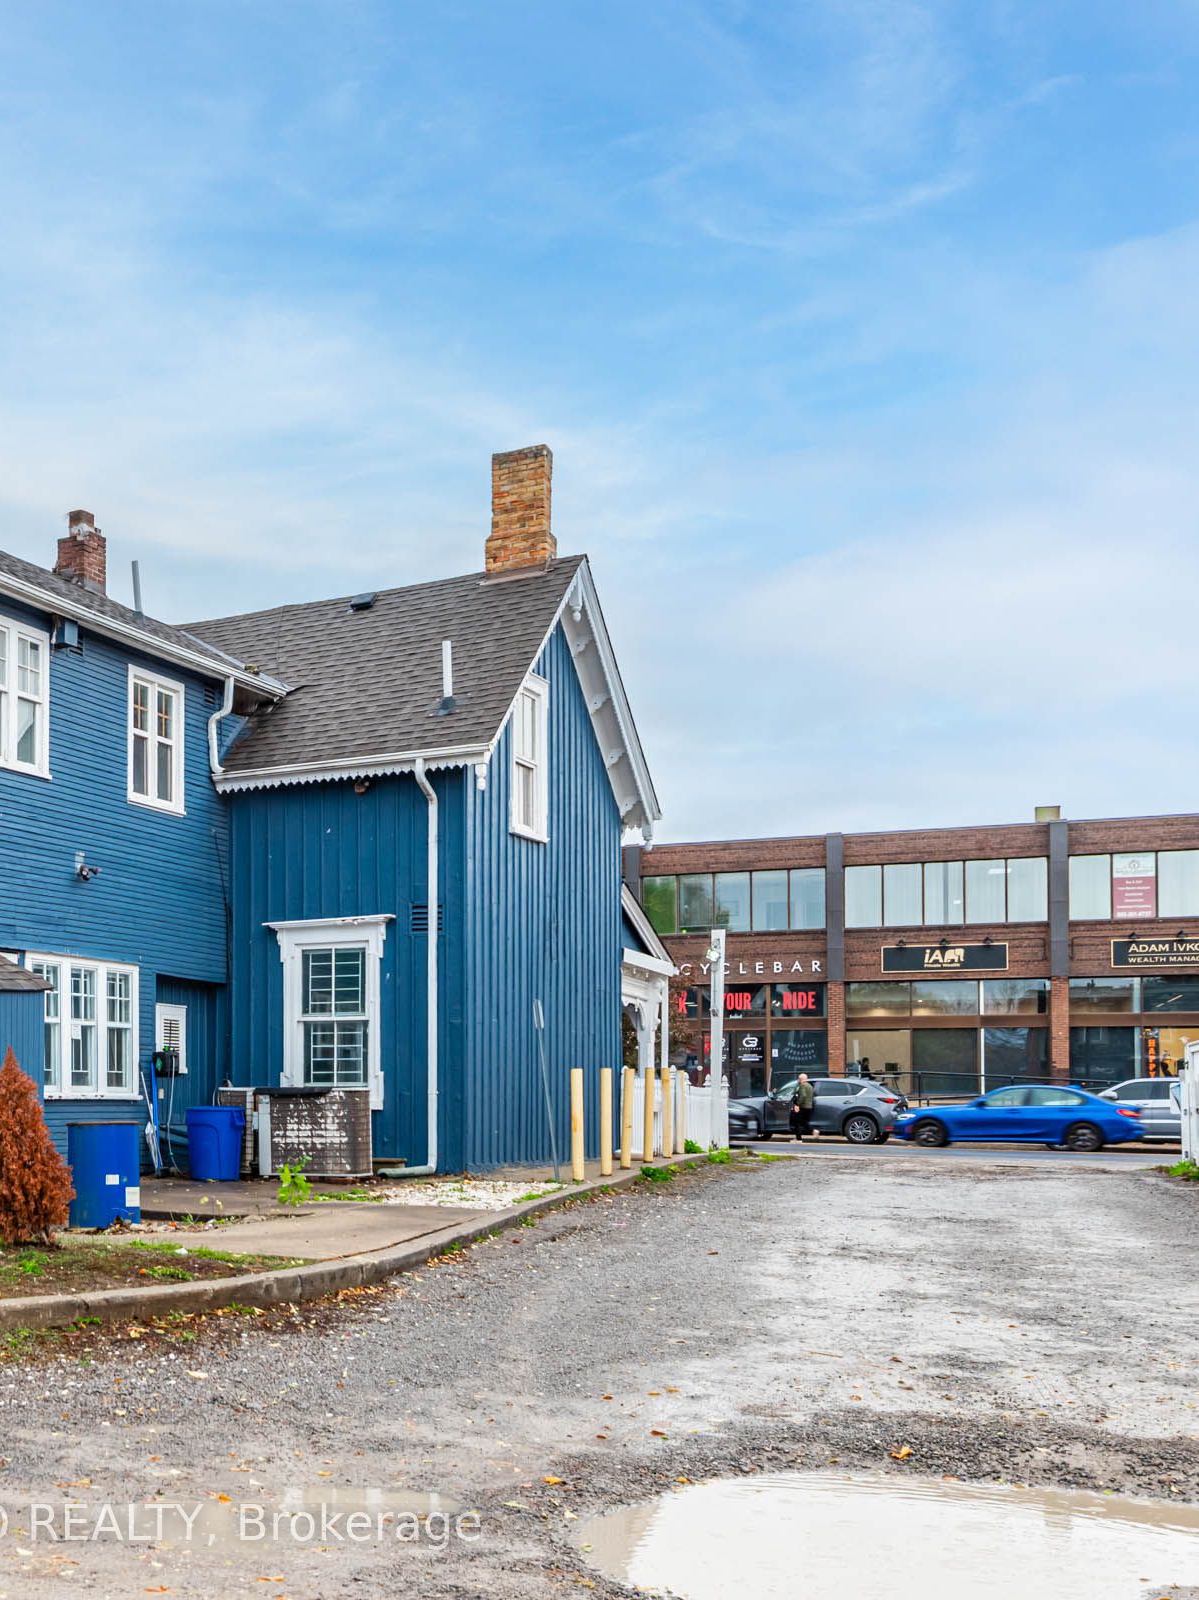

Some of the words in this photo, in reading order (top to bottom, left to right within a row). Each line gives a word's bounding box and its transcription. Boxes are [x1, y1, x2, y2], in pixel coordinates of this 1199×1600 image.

[1128, 943, 1169, 953] ADAM
[680, 960, 821, 976] CYCLEBAR
[783, 991, 816, 1010] RIDE
[1148, 1039, 1156, 1078] HAPPY
